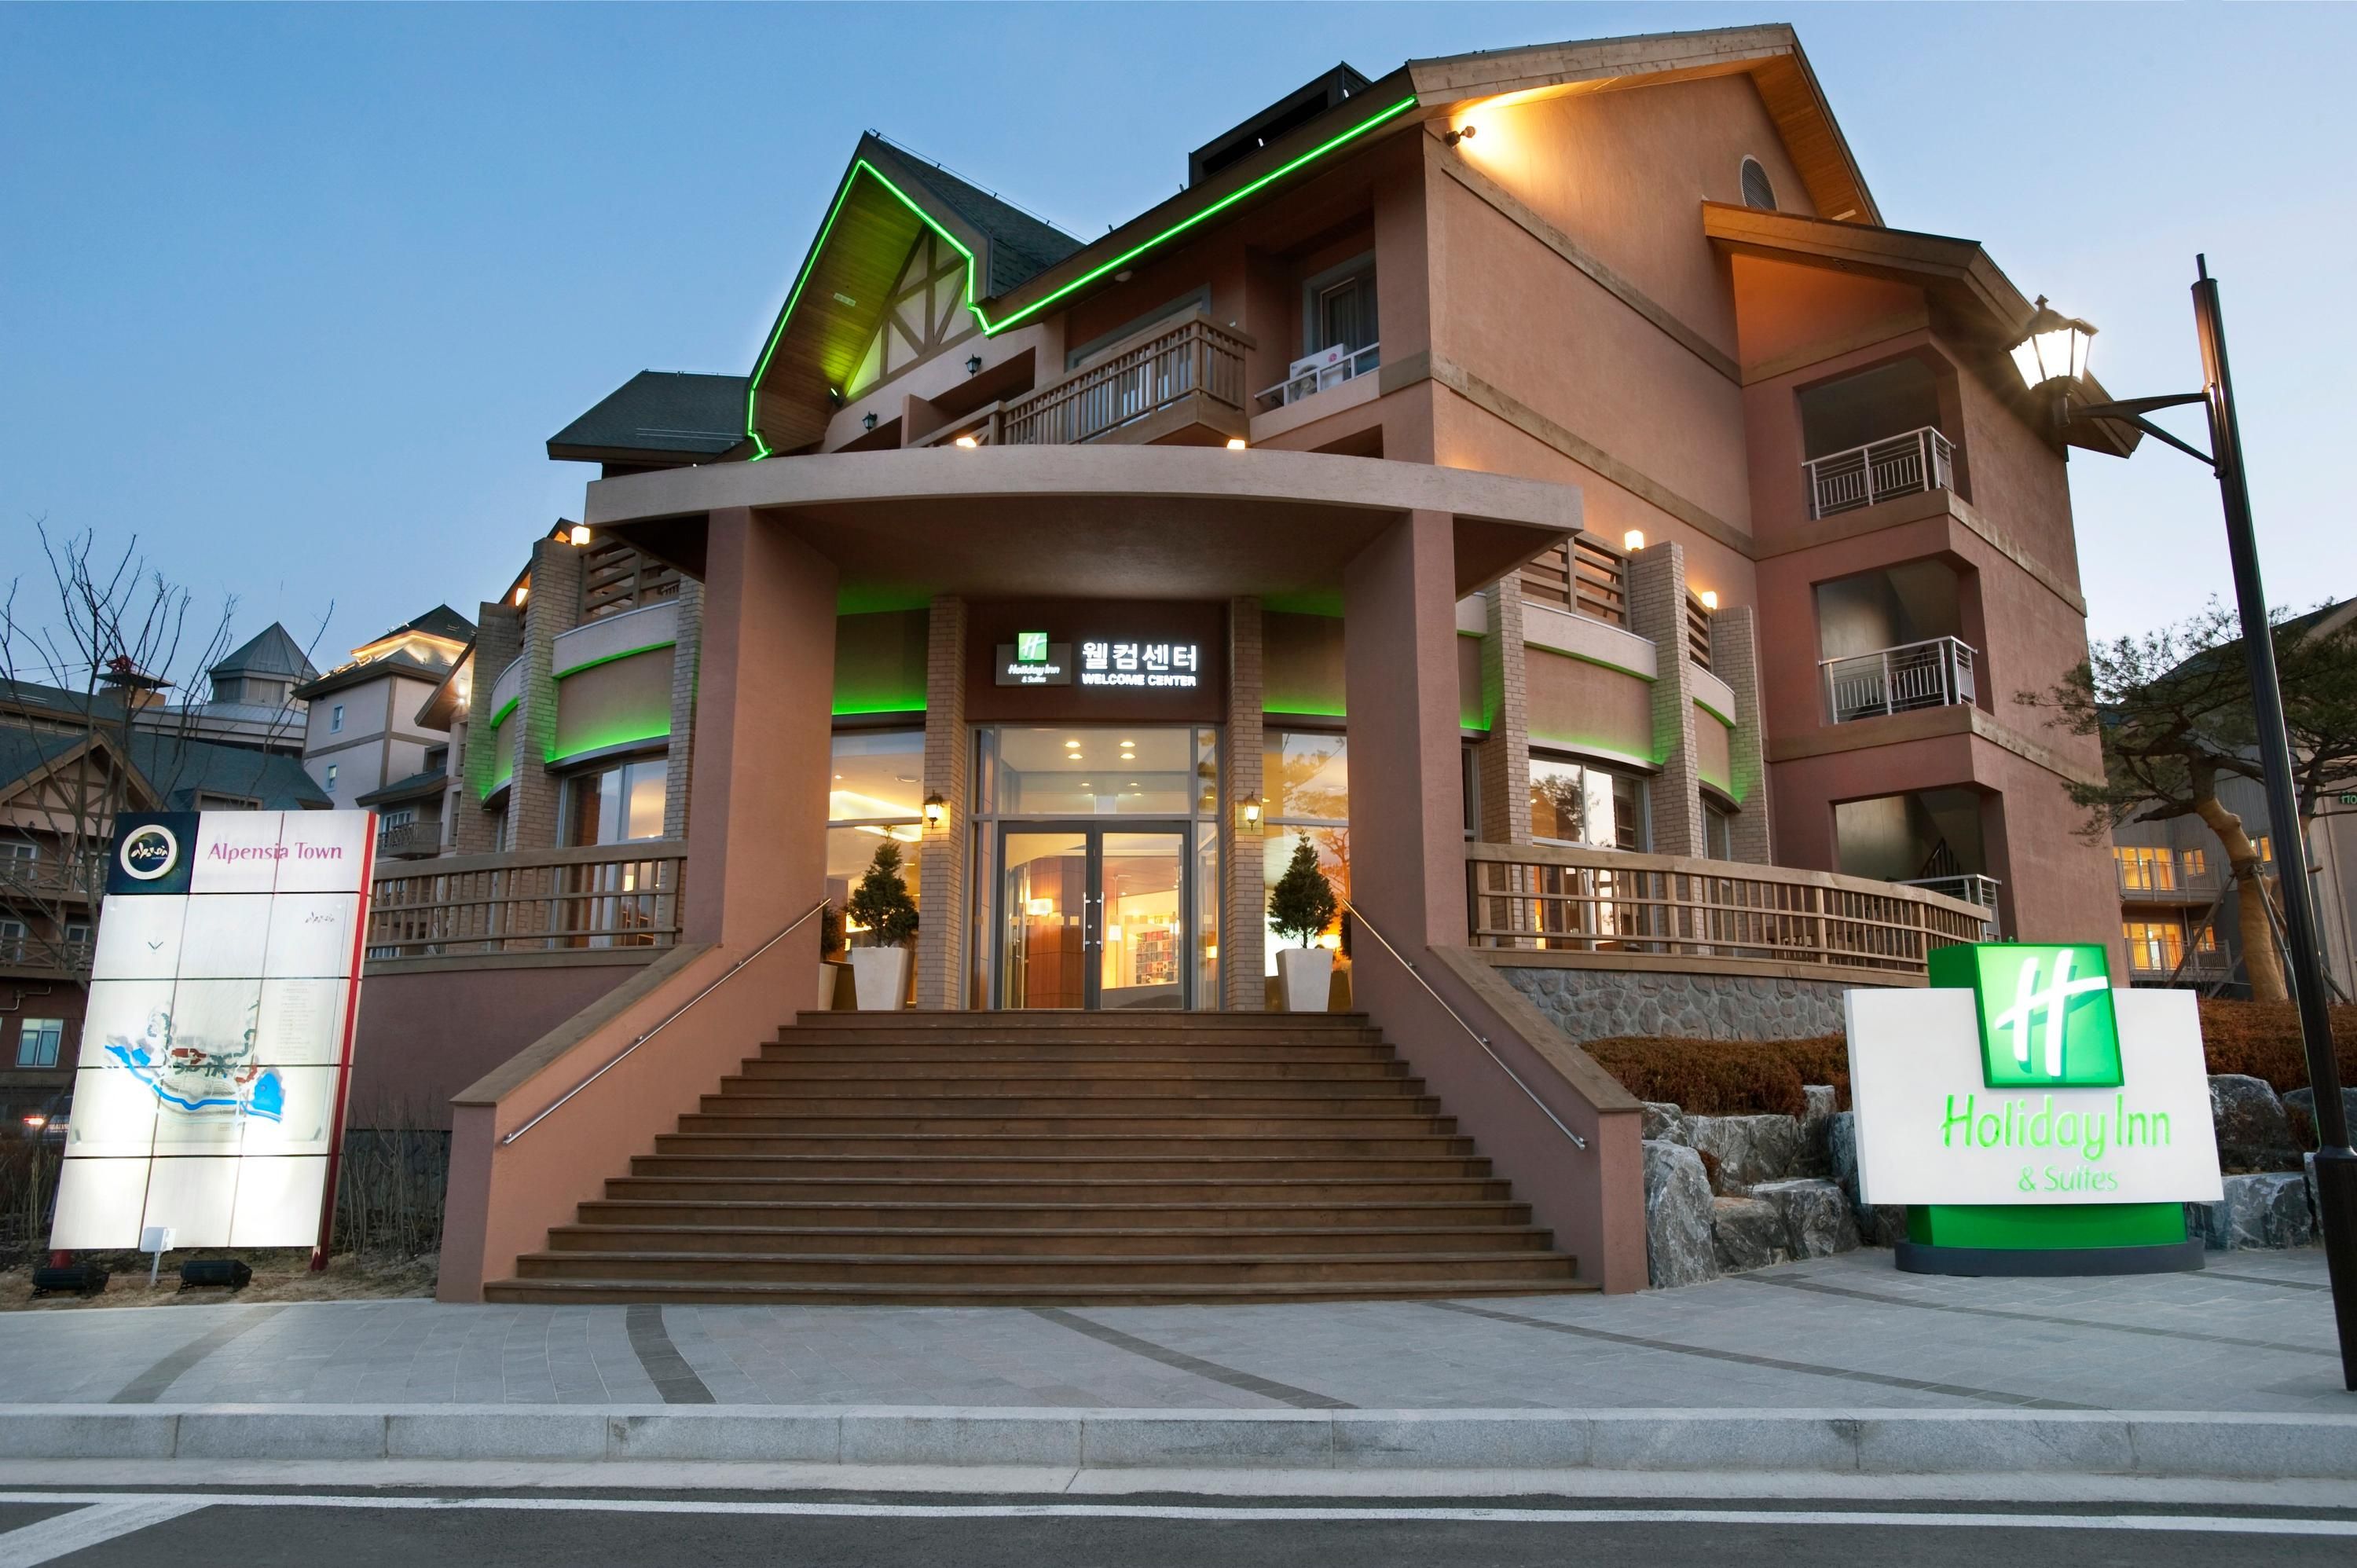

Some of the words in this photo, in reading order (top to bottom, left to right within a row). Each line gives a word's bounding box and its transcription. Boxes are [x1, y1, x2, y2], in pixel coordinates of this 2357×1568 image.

[1082, 643, 1197, 671] 웰컴센터
[1008, 664, 1044, 676] Holiday
[1044, 664, 1061, 674] Inn
[1082, 673, 1145, 685] WELCOME
[1148, 674, 1197, 686] CENTER
[208, 842, 288, 863] Alpensia
[295, 842, 343, 859] Town
[1939, 1094, 2106, 1161] Holiday
[2114, 1094, 2172, 1147] Inn
[2018, 1165, 2037, 1192] &
[2043, 1165, 2118, 1192] Suites
